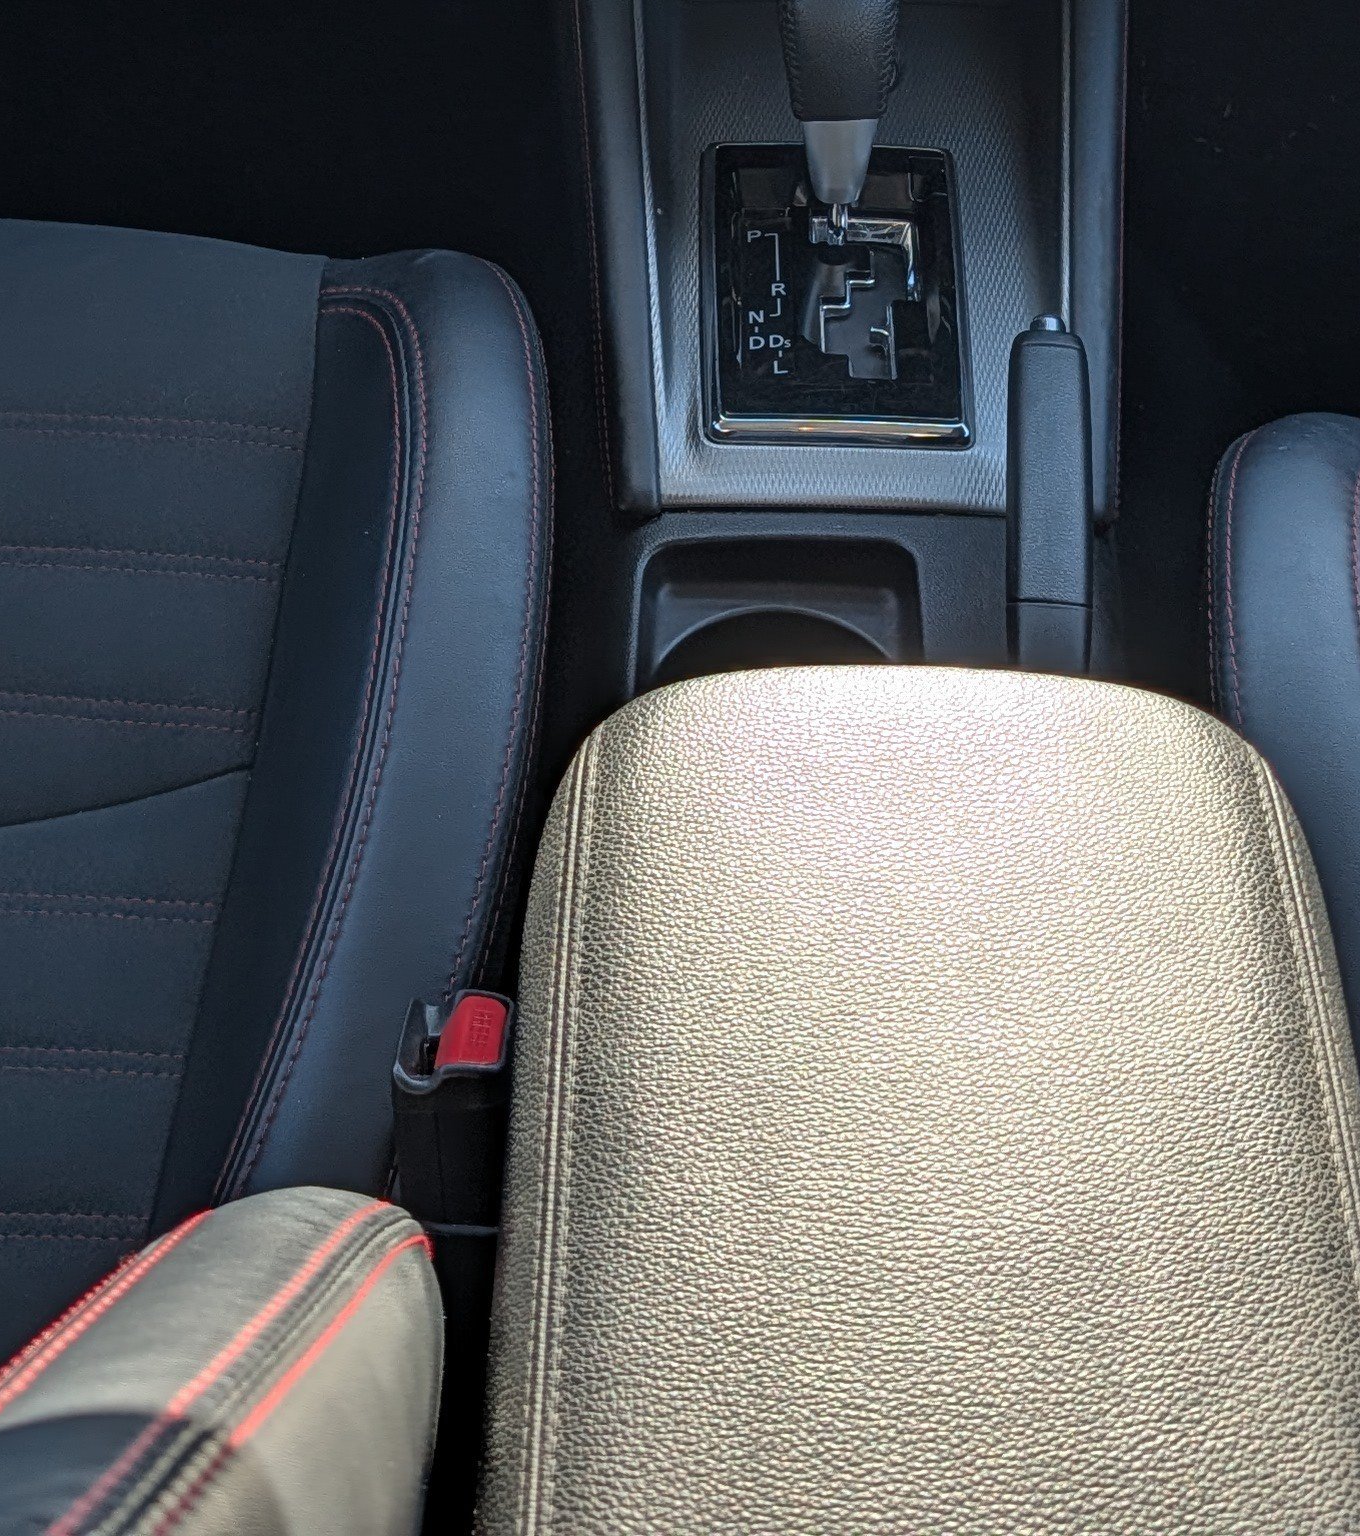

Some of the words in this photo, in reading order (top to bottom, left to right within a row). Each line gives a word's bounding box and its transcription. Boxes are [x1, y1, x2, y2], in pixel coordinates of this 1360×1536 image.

[747, 229, 762, 243] P
[771, 283, 786, 296] R
[749, 310, 764, 324] N
[749, 336, 765, 350] D
[773, 361, 788, 375] L
